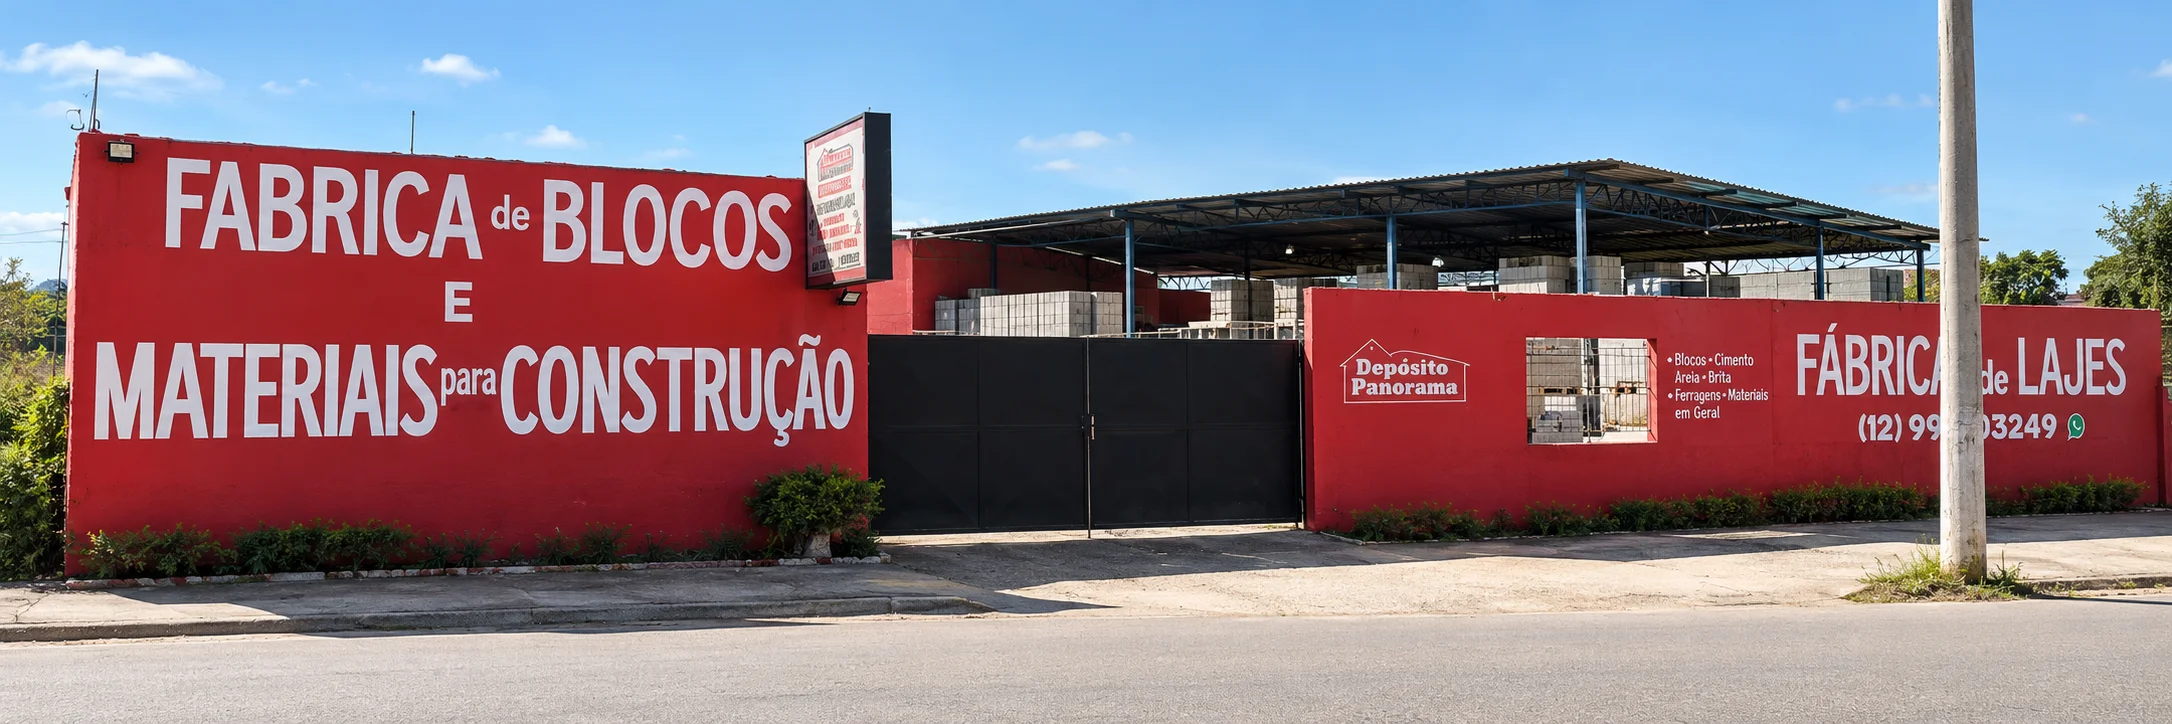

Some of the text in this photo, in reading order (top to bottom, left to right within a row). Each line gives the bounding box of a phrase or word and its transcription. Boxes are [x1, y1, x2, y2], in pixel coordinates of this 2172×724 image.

[165, 157, 792, 272] FABRICA de BLOCOS
[445, 281, 473, 323] E
[1355, 357, 1449, 380] Depósito
[1674, 352, 1754, 367] Blocos Cimento
[1981, 358, 2009, 395] de
[2018, 337, 2127, 396] LAJES
[1351, 378, 1459, 396] Panorama
[1674, 370, 1732, 384] Areia Brita
[94, 333, 855, 447] MATERIAIS para CONSTRUÇÃO
[1675, 388, 1769, 405] Ferragens Materiais
[1675, 405, 1720, 419] em Geral
[1859, 413, 1903, 443] (12)
